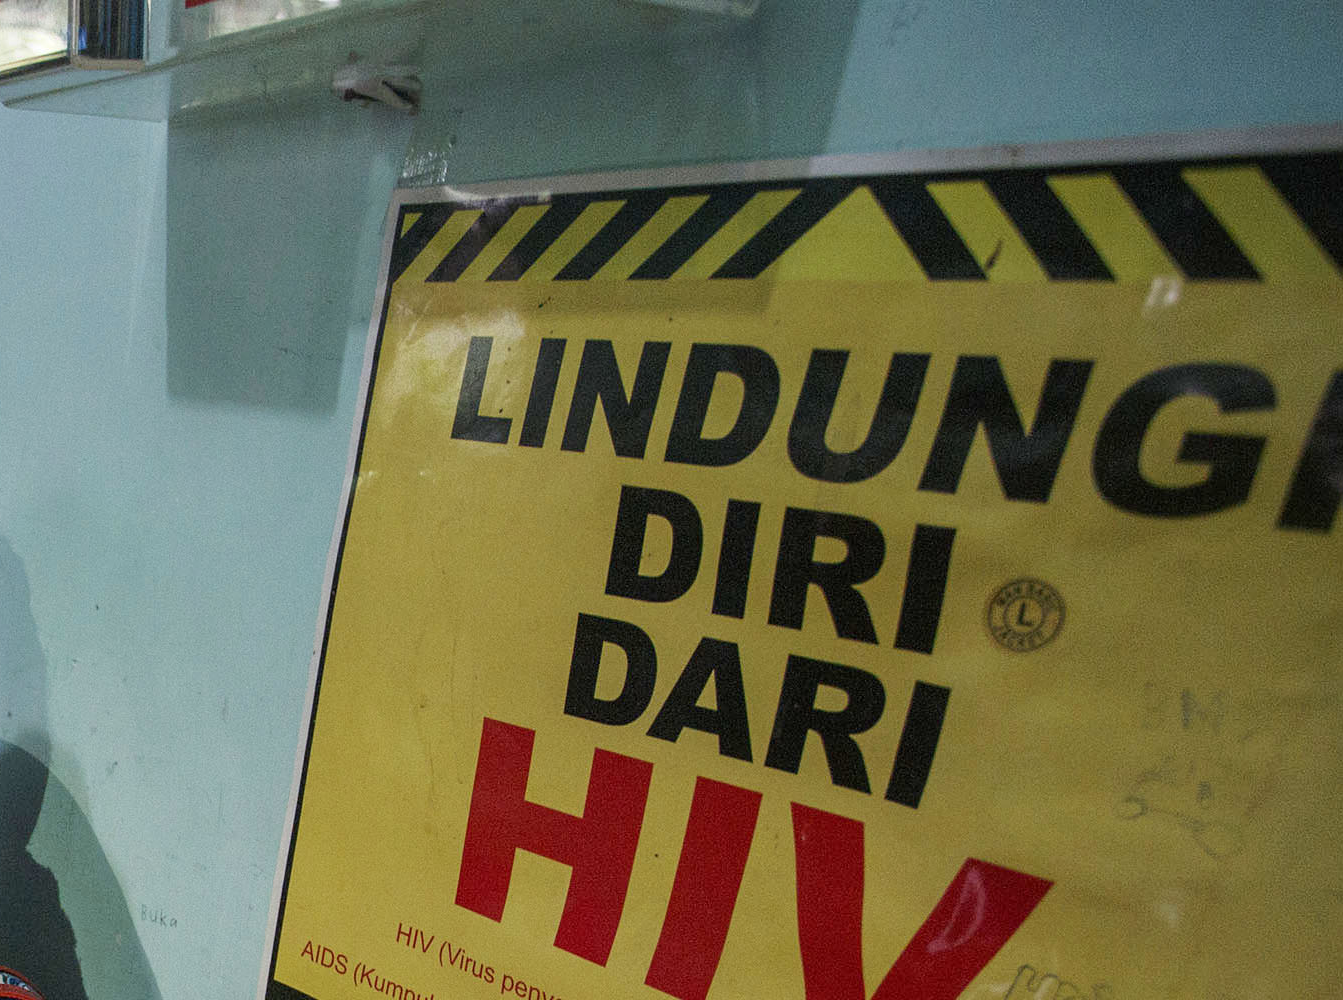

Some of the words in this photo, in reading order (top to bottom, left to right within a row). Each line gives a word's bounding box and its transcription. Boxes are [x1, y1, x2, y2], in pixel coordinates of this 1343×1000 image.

[451, 335, 1343, 534] LINDUNGI
[604, 484, 957, 656] DIRI
[563, 612, 952, 810] DARI
[300, 939, 349, 975] AIDS
[395, 922, 435, 955] HIV
[439, 940, 495, 984] (Virus
